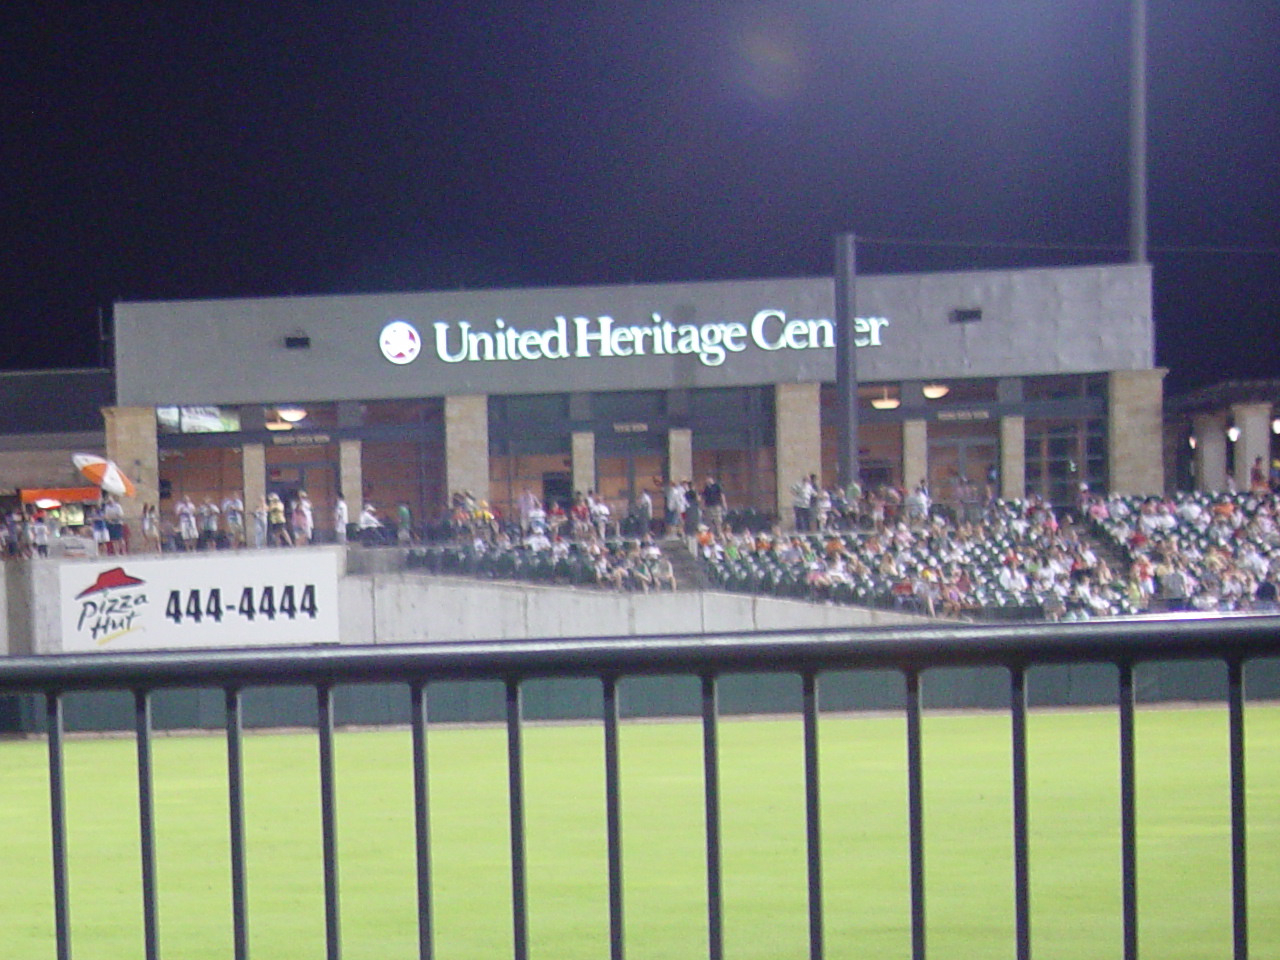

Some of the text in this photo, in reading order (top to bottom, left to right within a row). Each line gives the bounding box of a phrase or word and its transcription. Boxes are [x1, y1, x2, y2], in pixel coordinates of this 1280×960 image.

[433, 309, 889, 367] United Heritage Cener
[77, 590, 150, 632] Pizza
[165, 584, 319, 624] 444-4444
[90, 611, 142, 640] Hut
